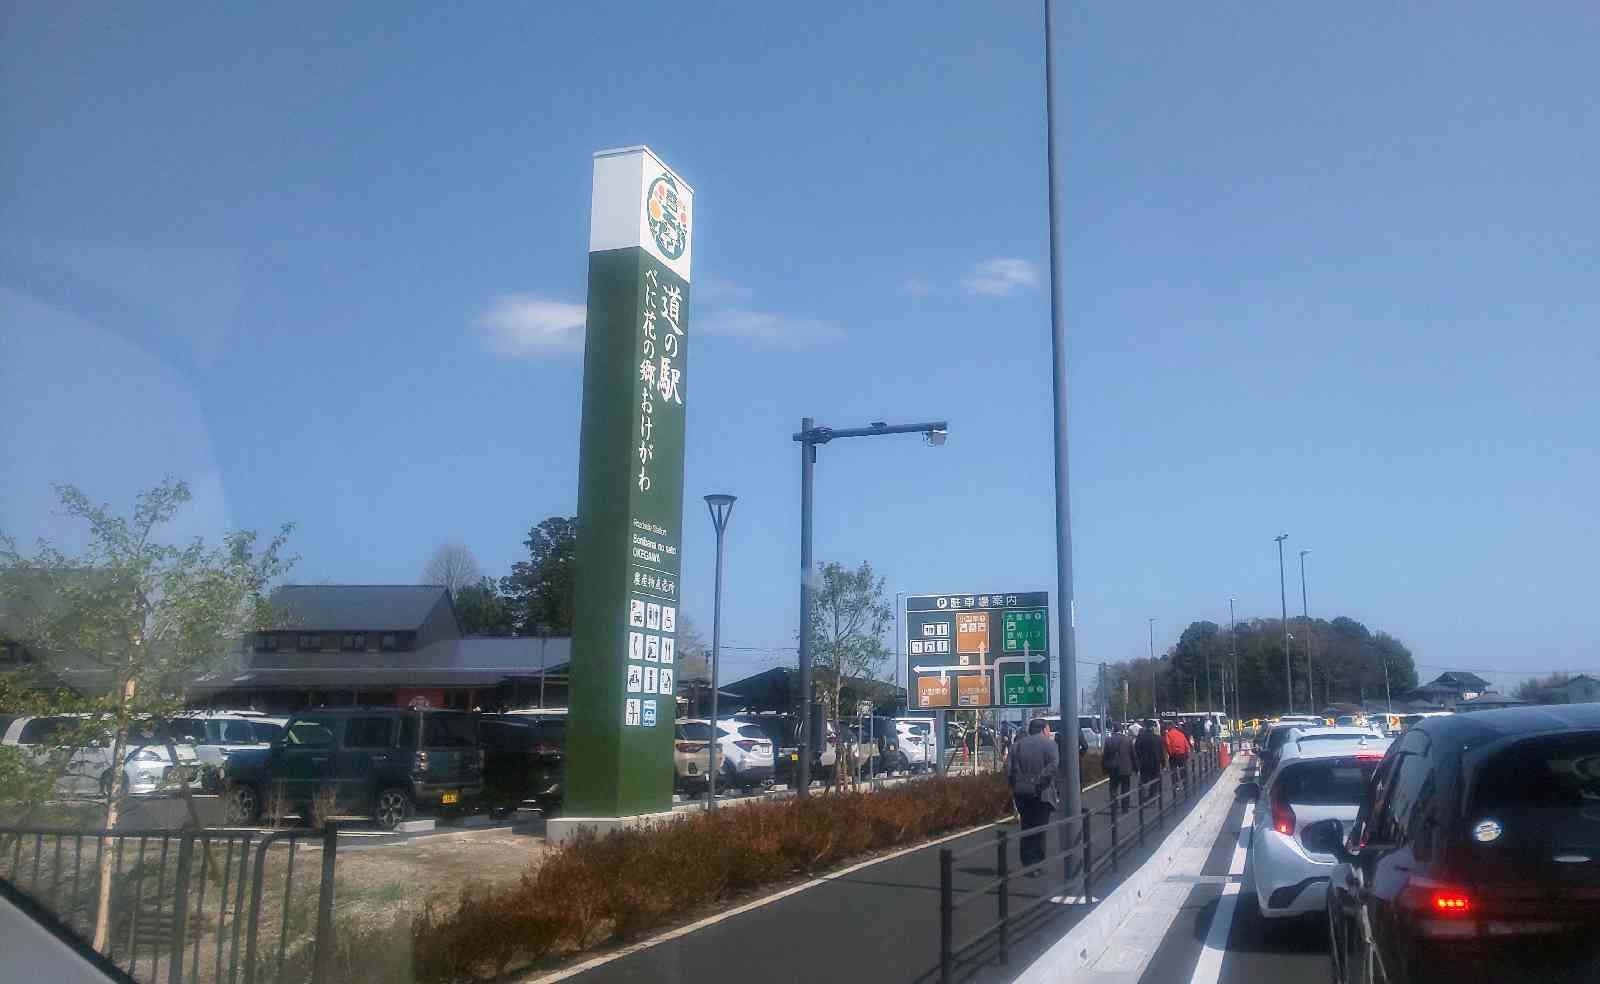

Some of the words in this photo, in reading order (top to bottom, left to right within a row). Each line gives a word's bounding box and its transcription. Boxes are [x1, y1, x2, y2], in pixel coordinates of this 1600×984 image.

[638, 267, 658, 493] べに花の郷おけがわ
[657, 285, 684, 405] 道の駅
